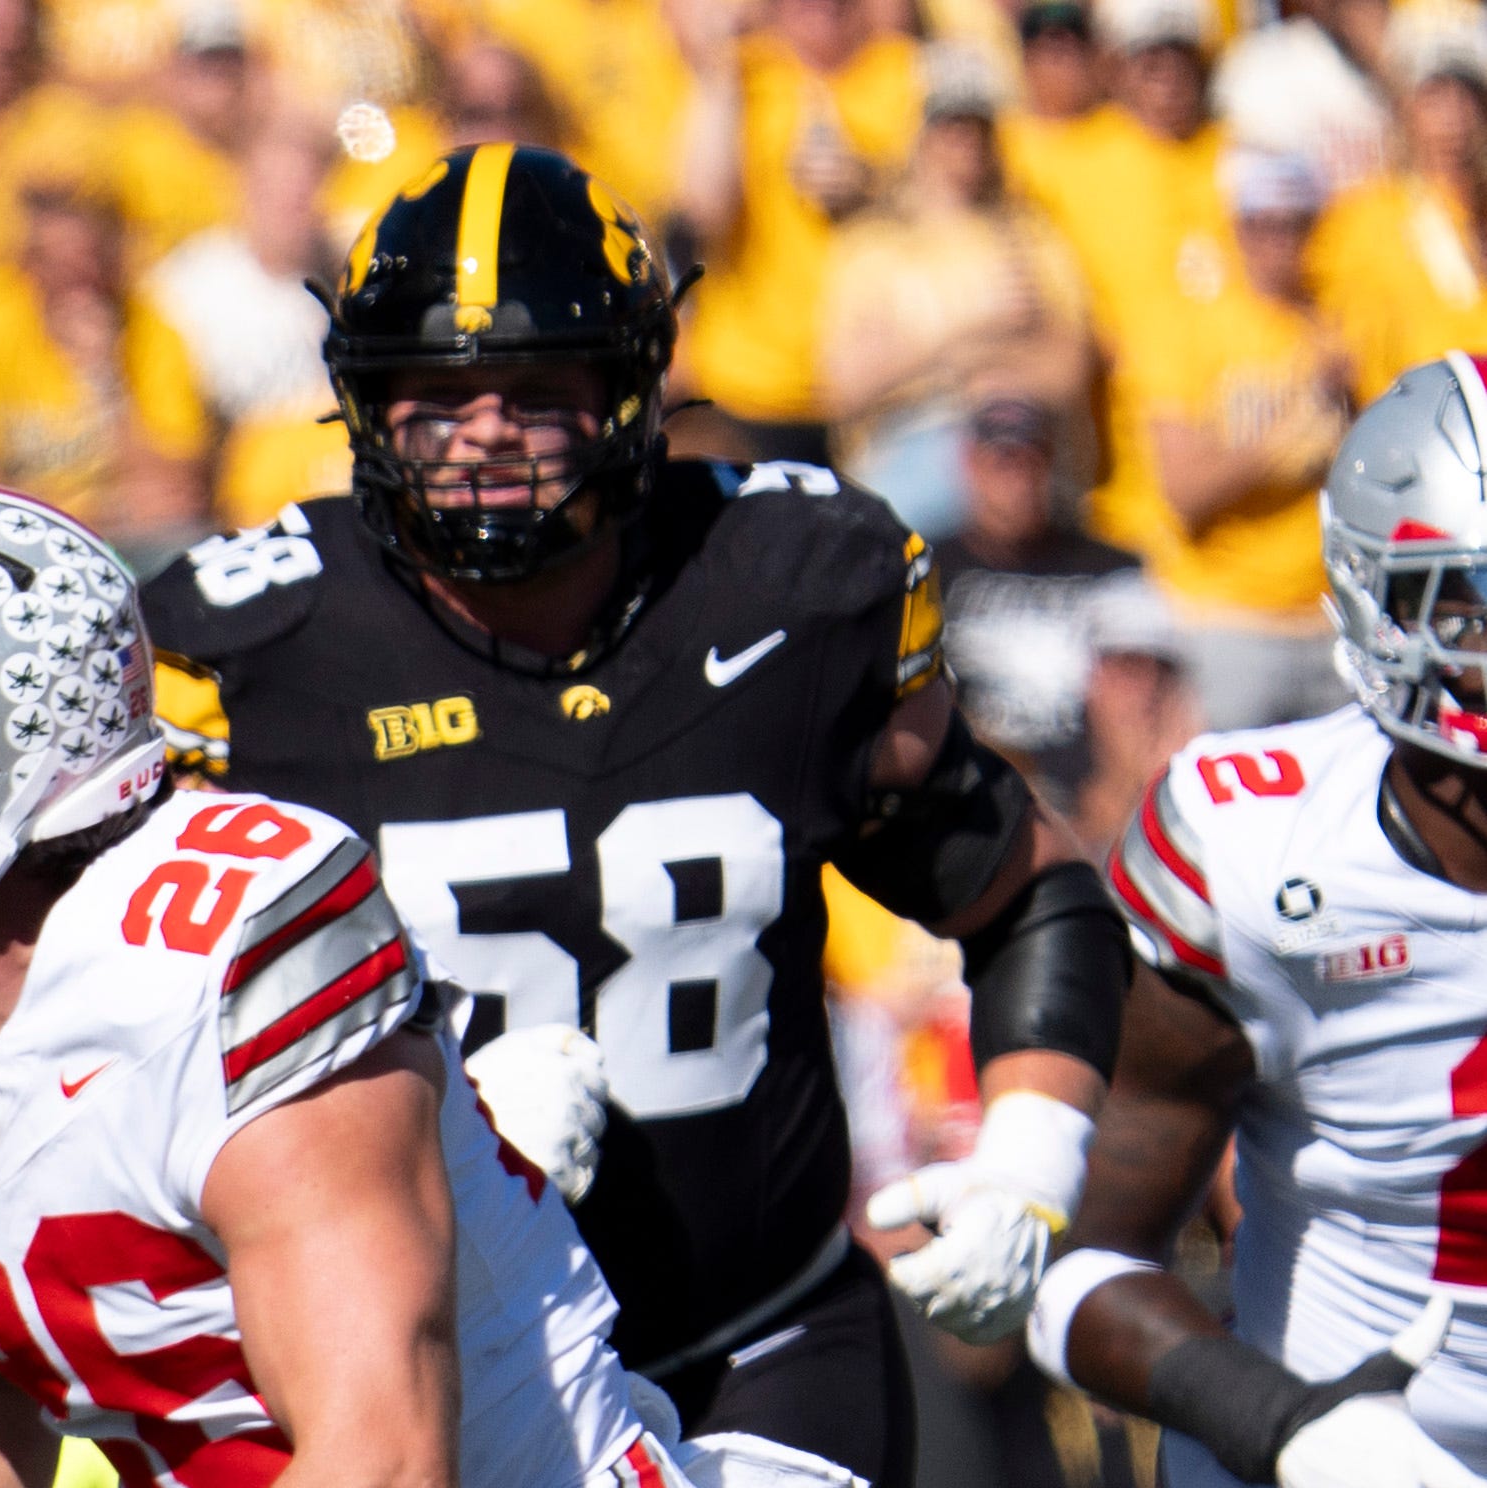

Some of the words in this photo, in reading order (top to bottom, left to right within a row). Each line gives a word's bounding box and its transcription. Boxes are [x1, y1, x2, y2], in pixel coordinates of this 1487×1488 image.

[1197, 748, 1306, 806] 2
[122, 802, 313, 957] 26
[378, 792, 785, 1121] 58
